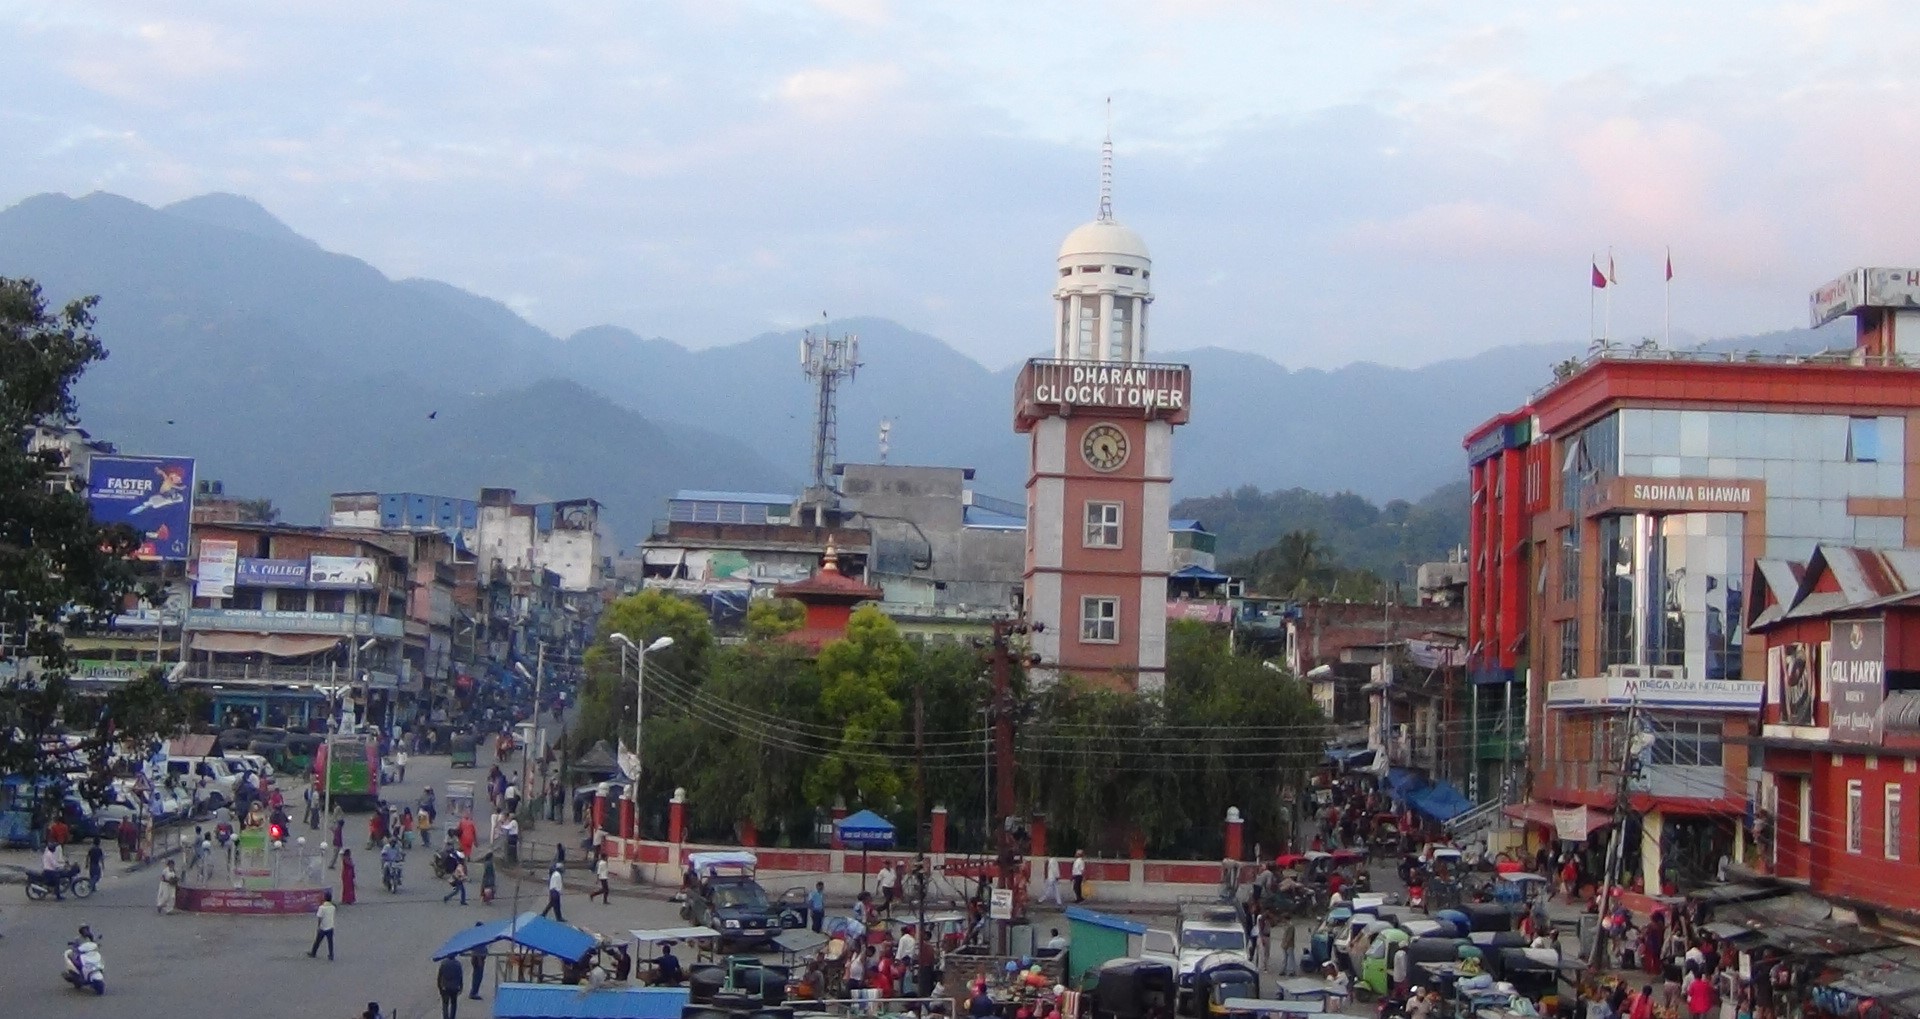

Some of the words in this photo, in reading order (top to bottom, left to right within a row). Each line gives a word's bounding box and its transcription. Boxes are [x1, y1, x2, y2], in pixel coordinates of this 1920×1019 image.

[1074, 366, 1146, 385] DHARAN
[1036, 384, 1105, 404] CLOCK
[1115, 387, 1183, 407] TOWER
[107, 478, 152, 490] FASTER
[1634, 484, 1694, 501] SADHANA
[1698, 486, 1750, 502] BHAWAN
[262, 566, 307, 576] COLLEGE
[1831, 660, 1848, 682] GILL
[1850, 661, 1881, 684] MARRY
[1640, 681, 1671, 690] MEGA
[1673, 682, 1697, 691] BANK
[1698, 682, 1727, 691] NEPAL
